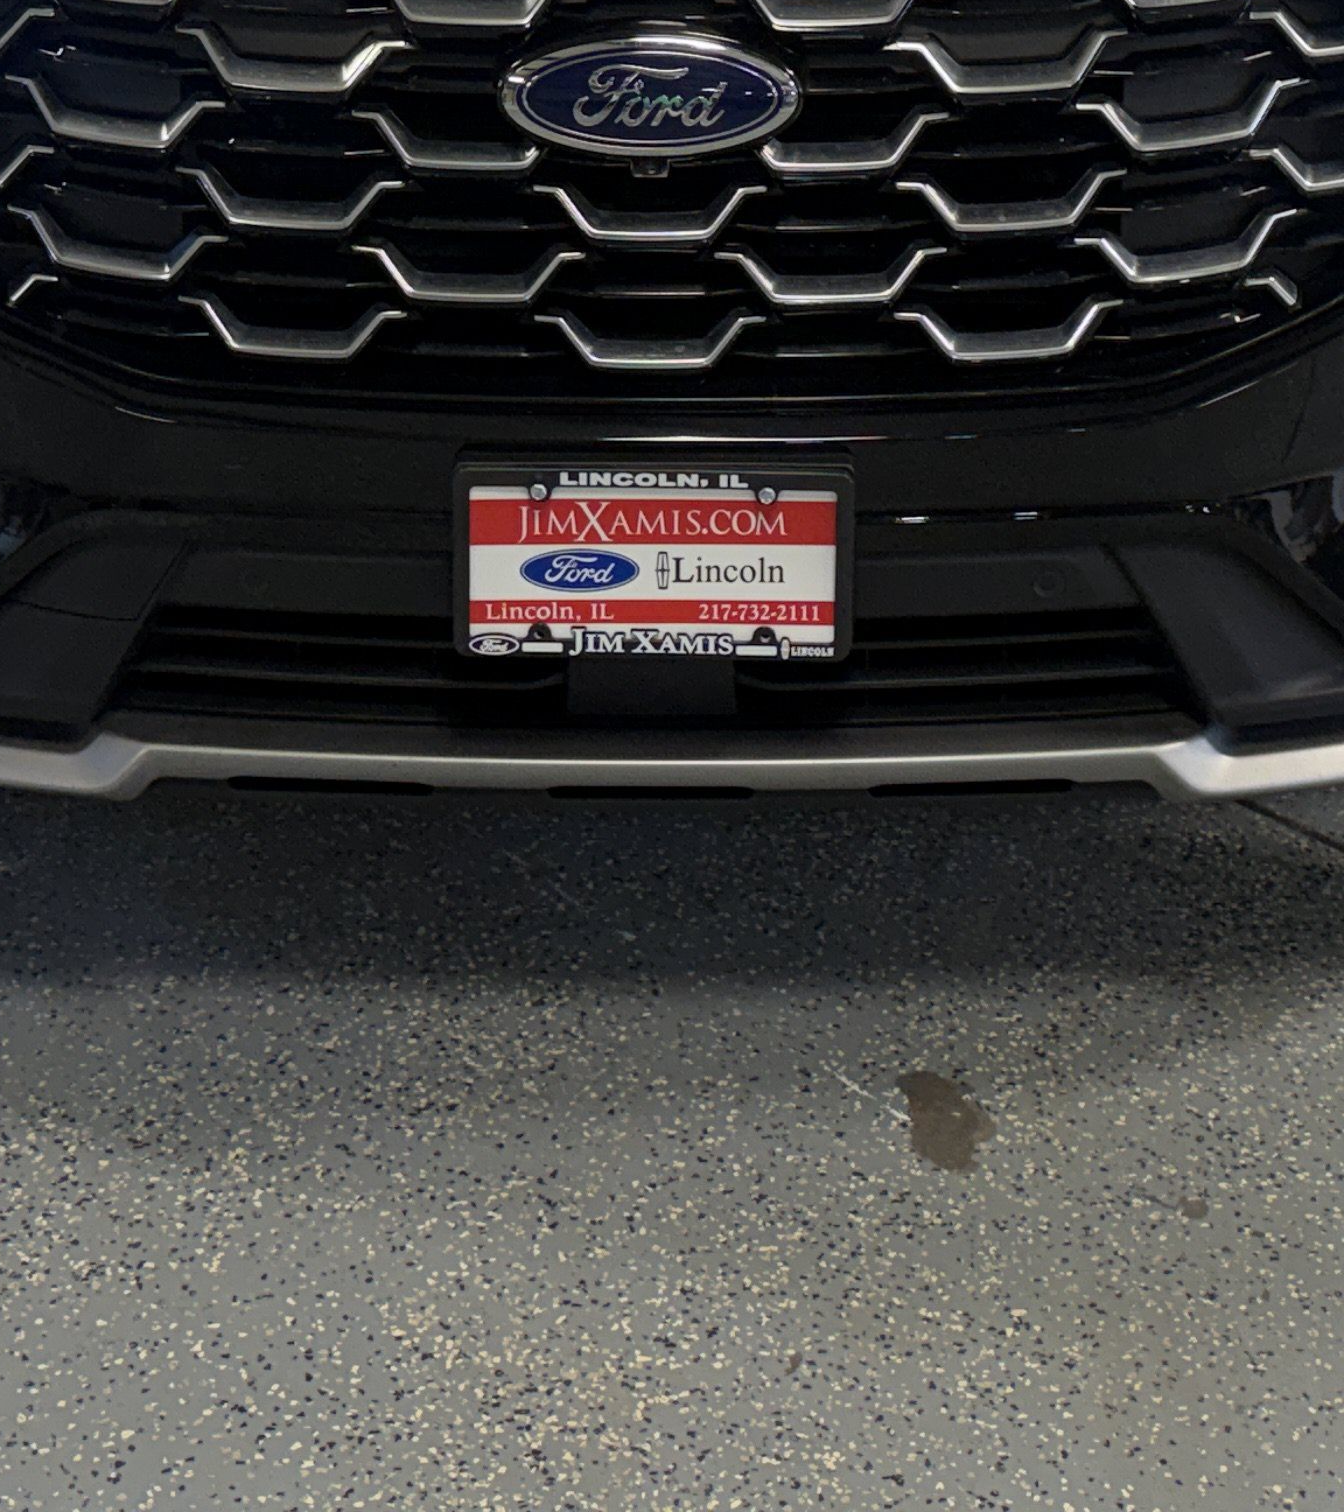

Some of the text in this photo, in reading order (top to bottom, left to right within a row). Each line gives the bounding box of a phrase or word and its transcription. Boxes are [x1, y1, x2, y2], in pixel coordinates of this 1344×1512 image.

[572, 63, 729, 128] Ford
[559, 471, 749, 489] LINCOLN, IL
[518, 501, 788, 543] JIMXAMIS.COM
[544, 554, 614, 583] Ford
[672, 557, 785, 583] Lincoln
[486, 602, 615, 622] Lincoln, IL
[698, 603, 820, 622] 217-732-2111
[568, 627, 734, 656] JIM XAMIS
